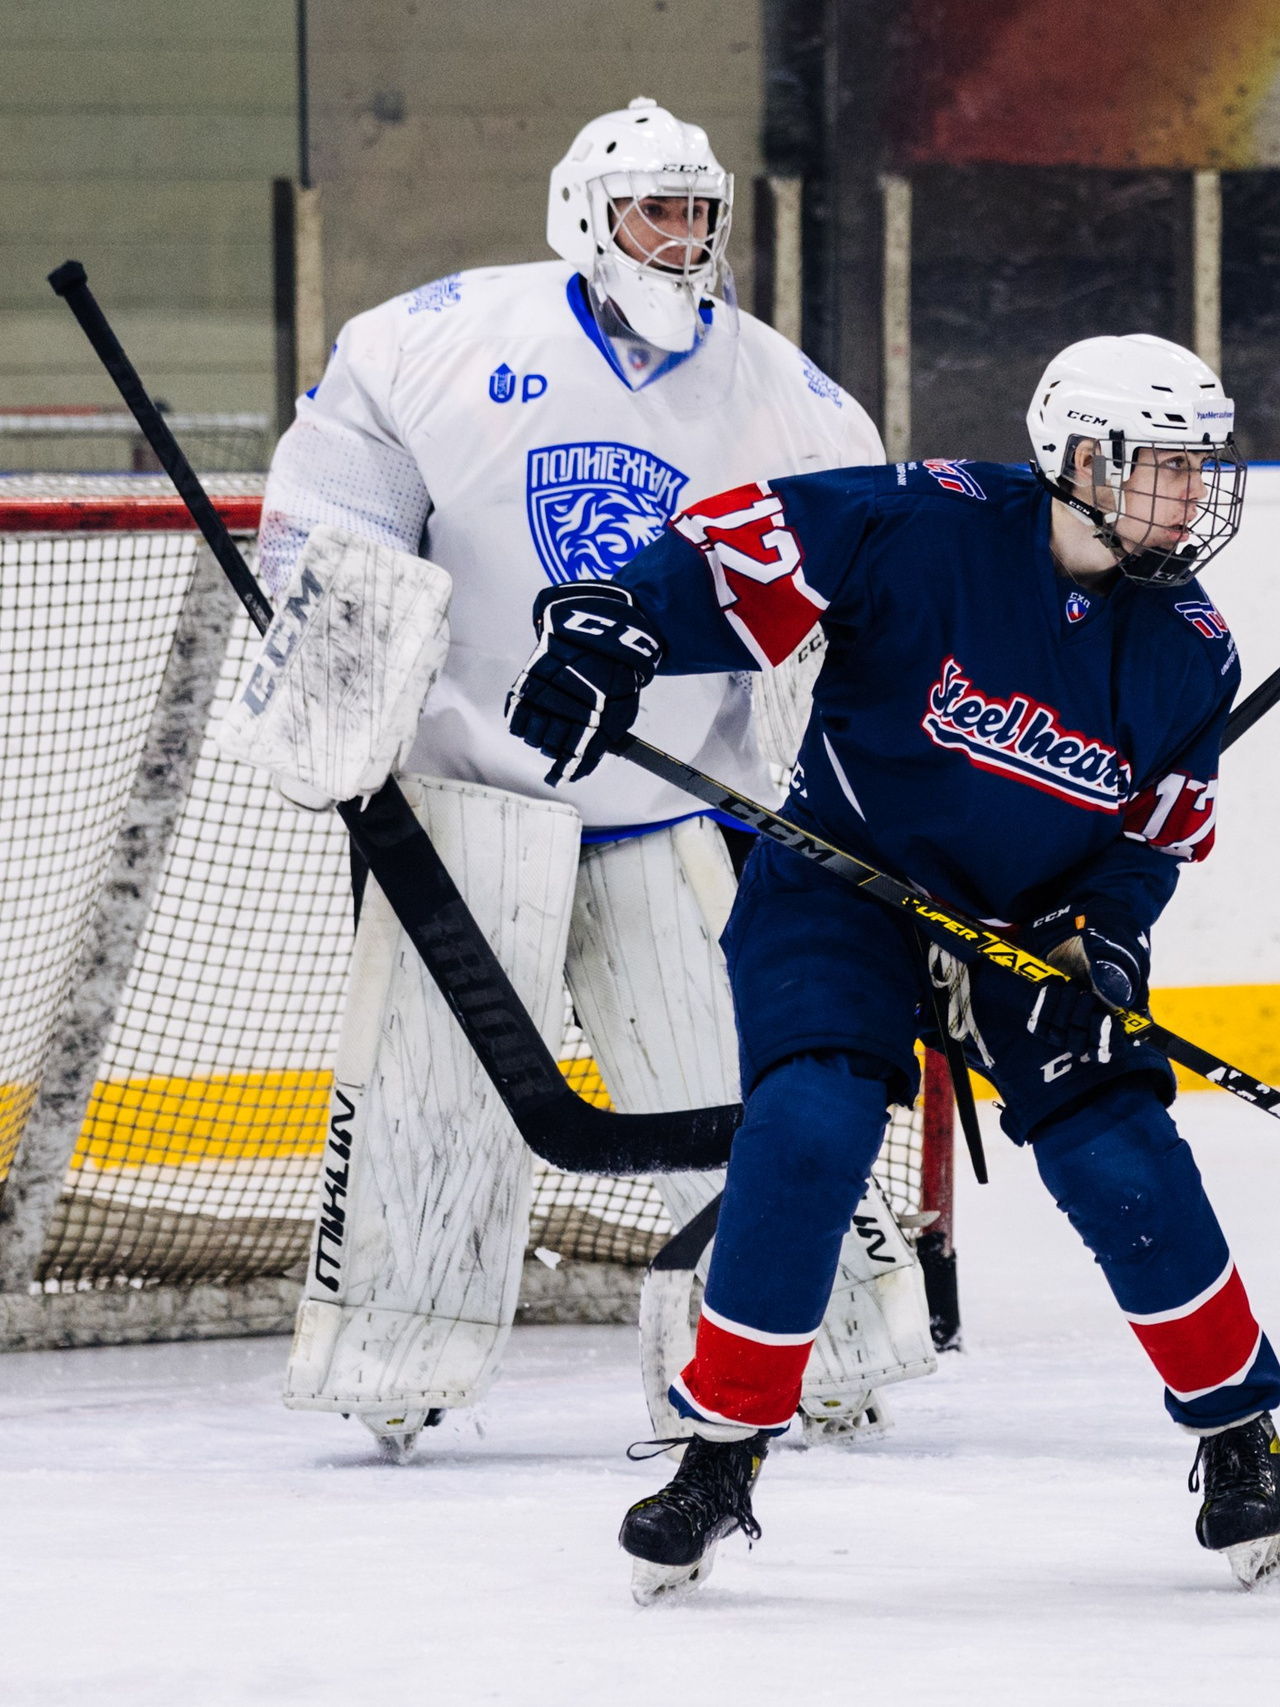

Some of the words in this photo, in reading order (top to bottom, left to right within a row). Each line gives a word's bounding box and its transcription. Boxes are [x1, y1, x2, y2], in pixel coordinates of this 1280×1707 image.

[1066, 410, 1109, 427] CCM
[531, 446, 683, 510] ПОЛИТЕХНИК
[1068, 501, 1091, 516] CCM
[673, 496, 803, 609] 12
[241, 567, 324, 716] CCM
[563, 610, 662, 663] CC
[798, 634, 826, 664] CC
[930, 658, 1029, 747] Steel
[717, 796, 838, 864] CCM
[1033, 905, 1071, 928] CCM
